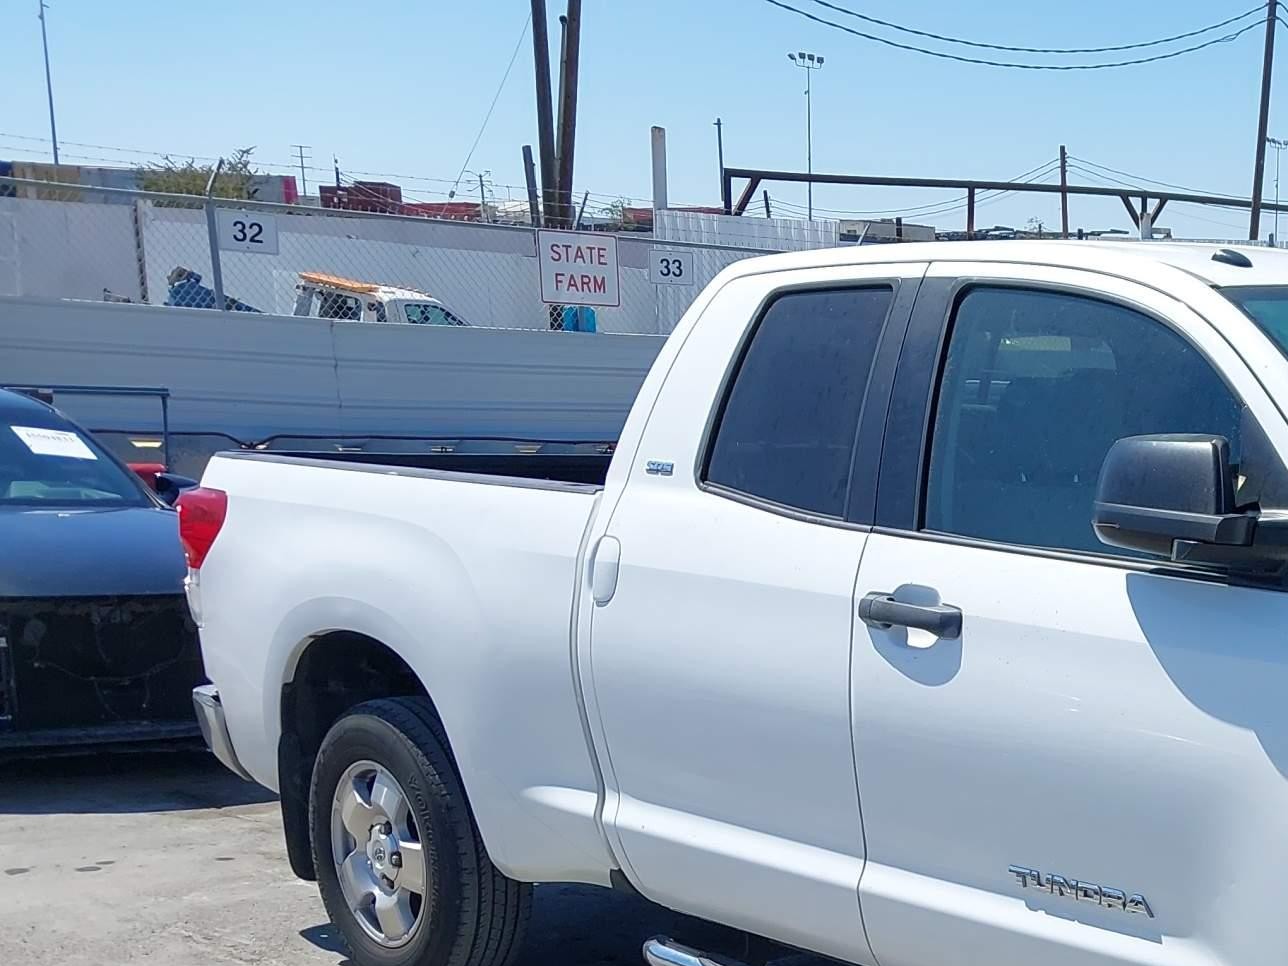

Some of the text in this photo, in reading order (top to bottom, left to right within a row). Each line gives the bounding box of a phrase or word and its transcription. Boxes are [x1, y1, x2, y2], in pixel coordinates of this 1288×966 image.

[233, 220, 264, 243] 32
[550, 243, 608, 266] STATE
[659, 258, 683, 277] 33
[555, 272, 607, 294] FARM
[1008, 864, 1155, 918] TUNDRA
